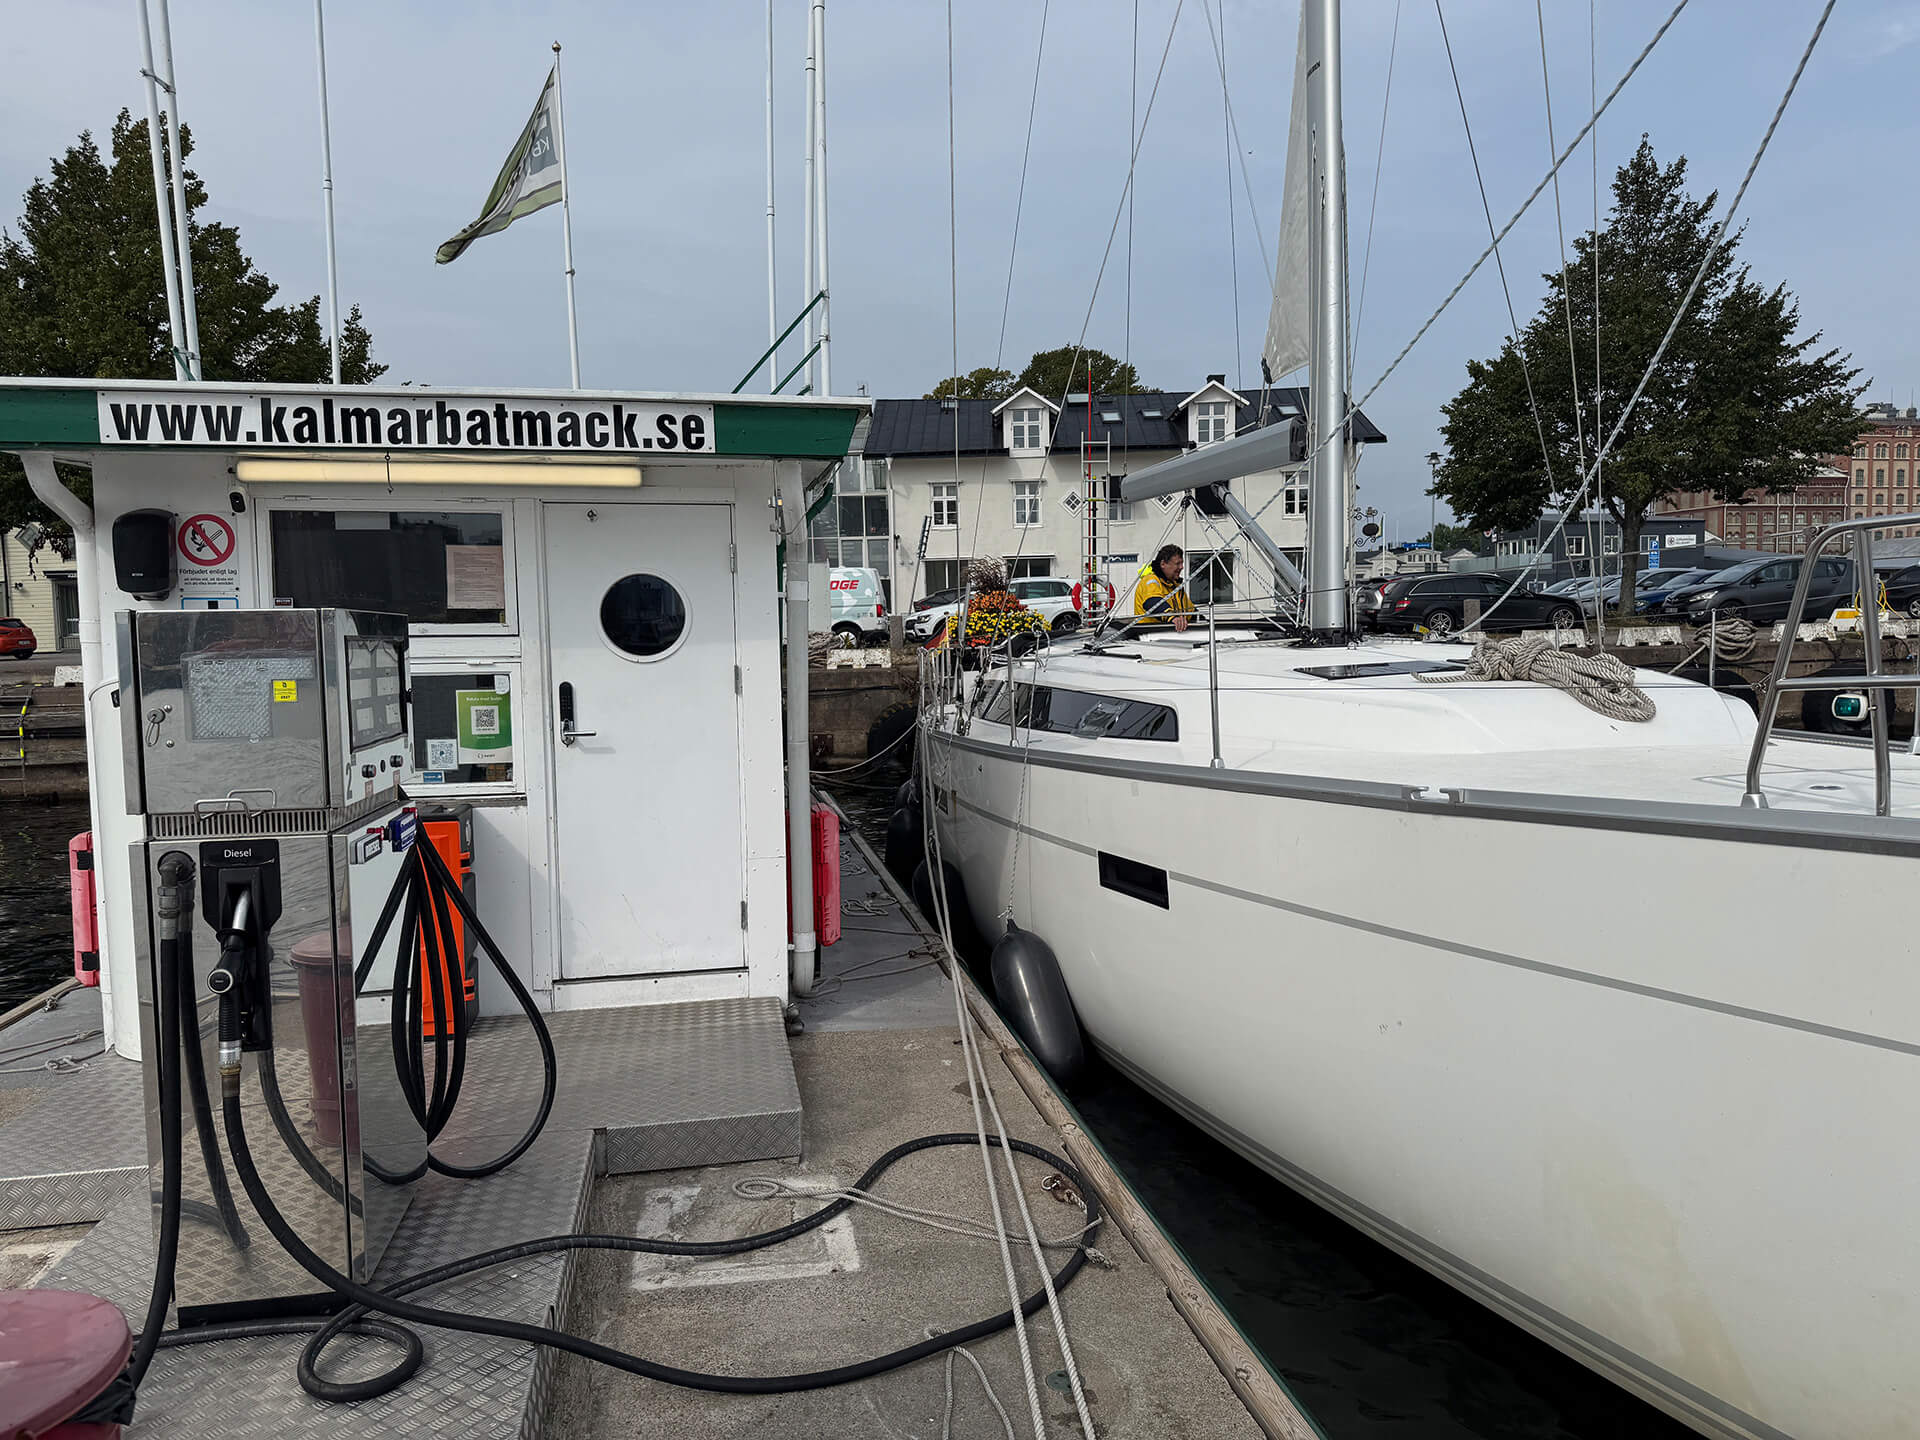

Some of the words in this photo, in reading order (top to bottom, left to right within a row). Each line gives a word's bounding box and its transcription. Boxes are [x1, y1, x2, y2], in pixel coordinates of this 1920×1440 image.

[109, 397, 705, 450] www.kalmarbatmack.se
[179, 568, 208, 576] Förbjudet
[209, 568, 226, 576] enligt
[228, 568, 237, 576] lag
[346, 762, 352, 800] 2
[224, 848, 252, 858] Diesel
